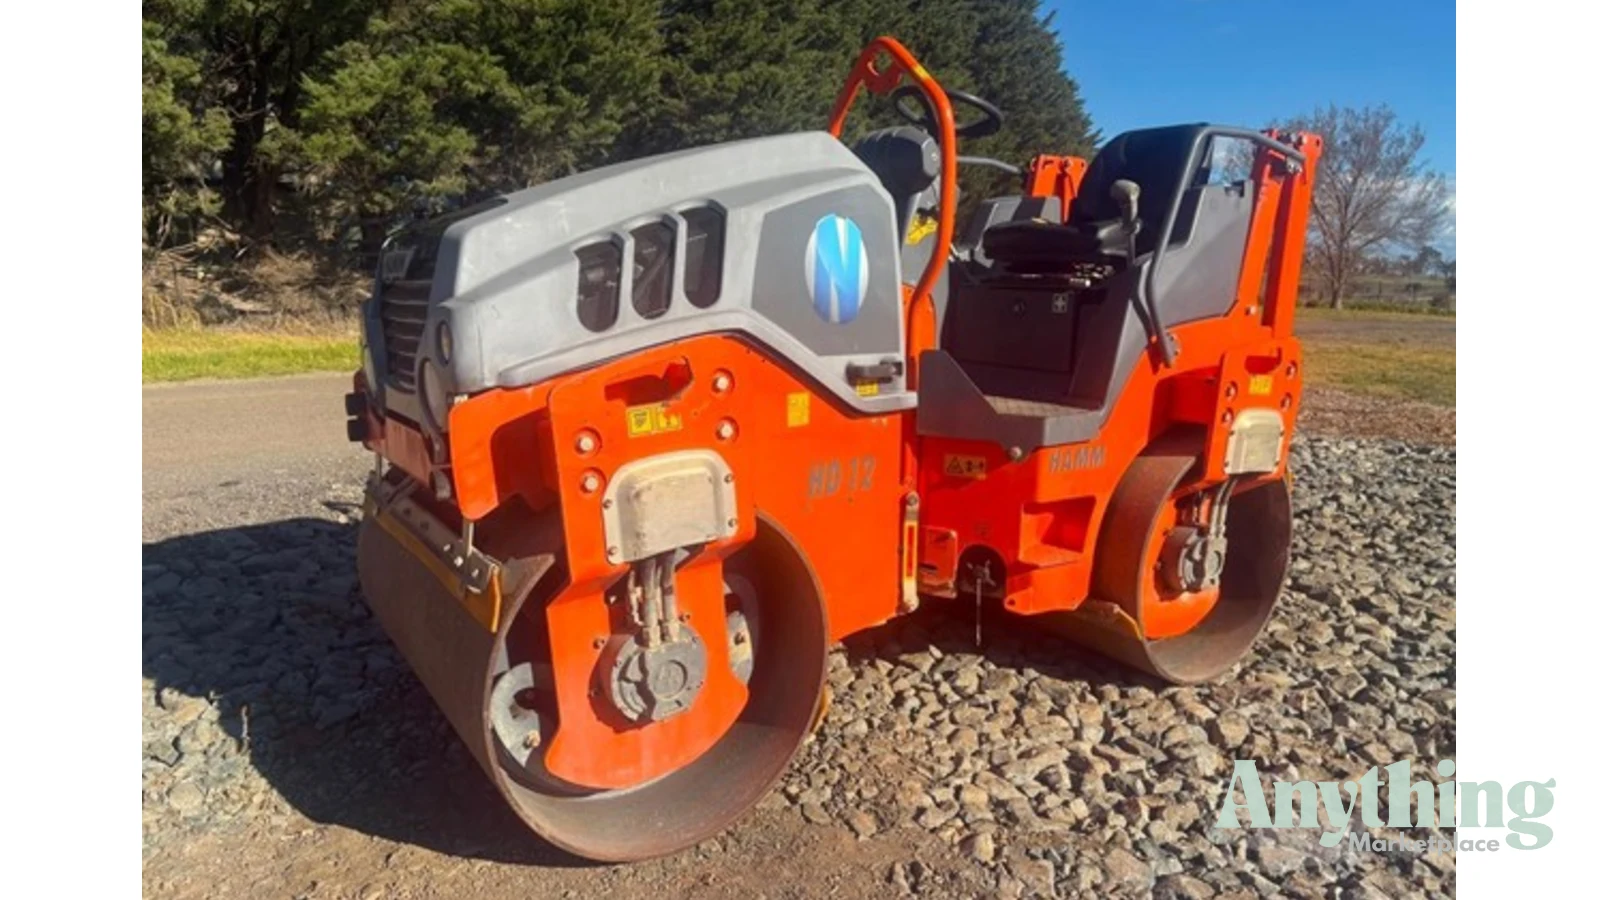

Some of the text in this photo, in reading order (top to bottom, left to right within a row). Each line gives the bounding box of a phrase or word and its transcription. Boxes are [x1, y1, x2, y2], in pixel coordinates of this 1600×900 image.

[813, 213, 862, 324] N
[808, 455, 876, 498] HD 12
[1049, 446, 1105, 473] HAMM
